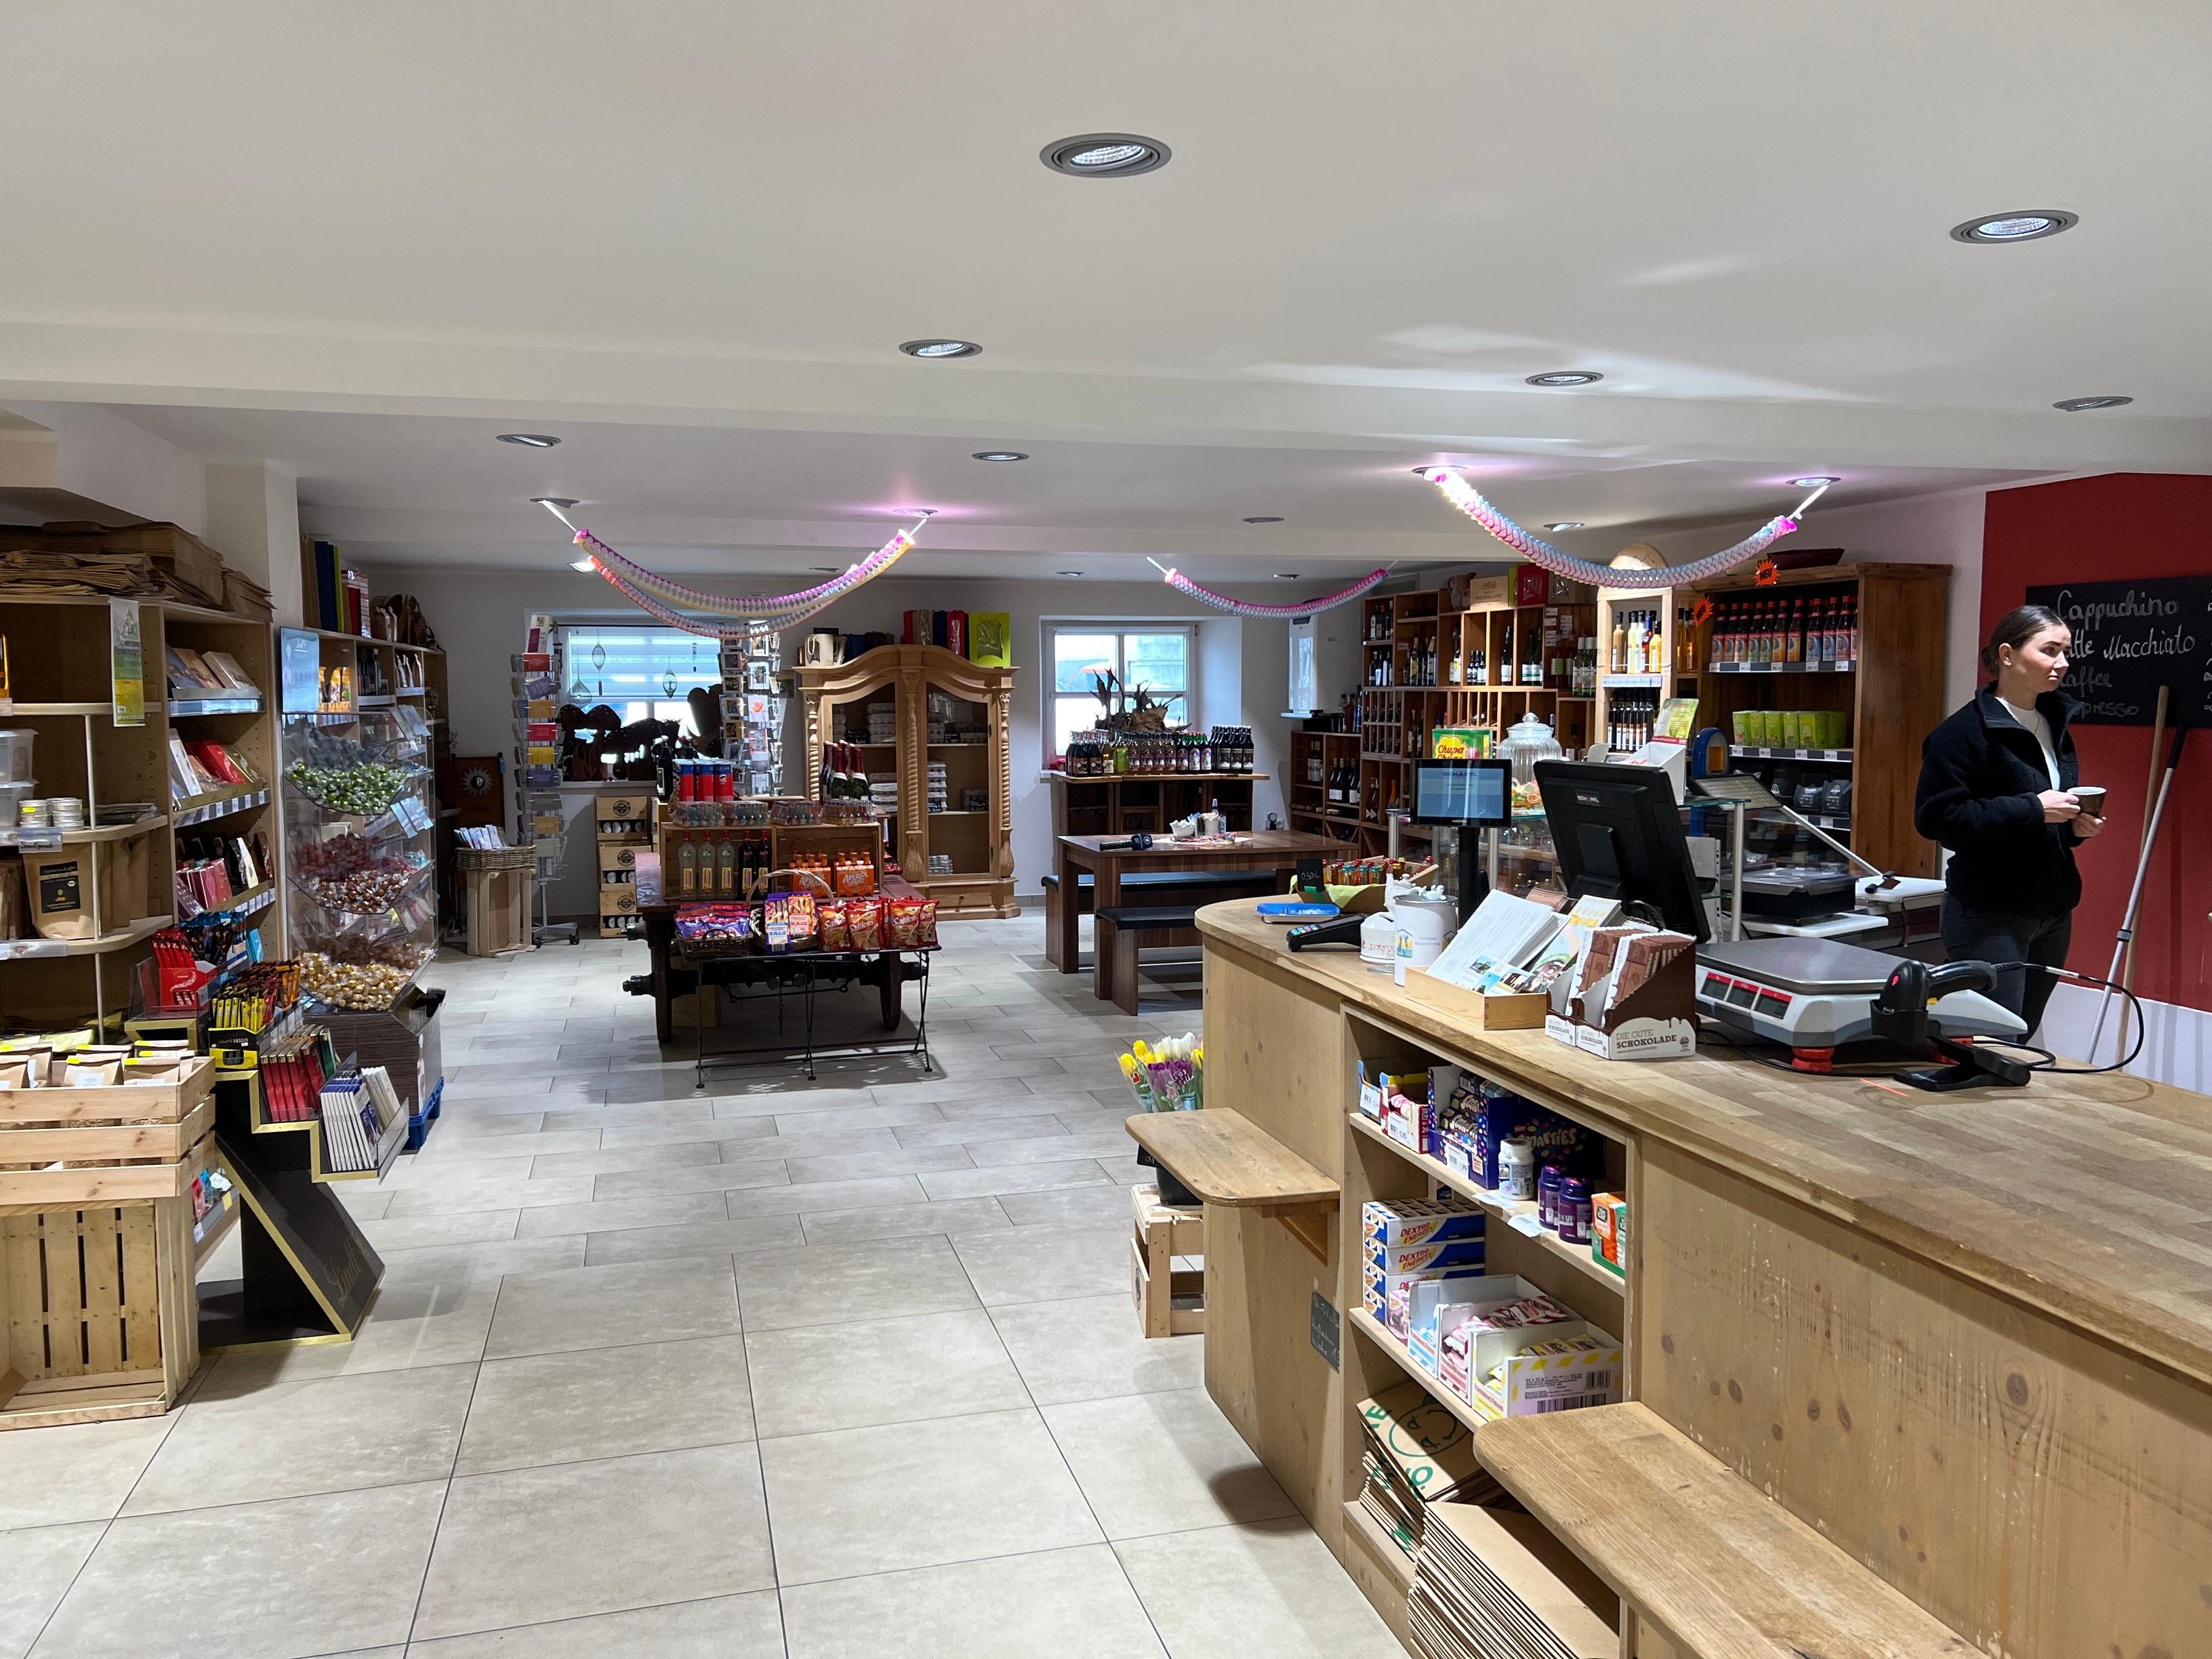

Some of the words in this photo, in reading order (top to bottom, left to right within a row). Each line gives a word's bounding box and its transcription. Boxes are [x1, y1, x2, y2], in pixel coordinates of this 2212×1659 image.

[1759, 567, 1773, 581] NEU
[2057, 590, 2180, 631] Cappuchino
[2066, 628, 2095, 659] tte
[2103, 624, 2196, 661] Macchiato
[2060, 665, 2114, 699] affee
[2075, 701, 2140, 720] presso
[1438, 744, 1465, 756] Chupa
[842, 870, 869, 884] APEROL
[1632, 1029, 1654, 1038] GUTE
[1616, 1034, 1677, 1049] SCHOKOLADE
[1400, 1222, 1431, 1237] DEXTRO
[1399, 1248, 1429, 1263] DEXTRO
